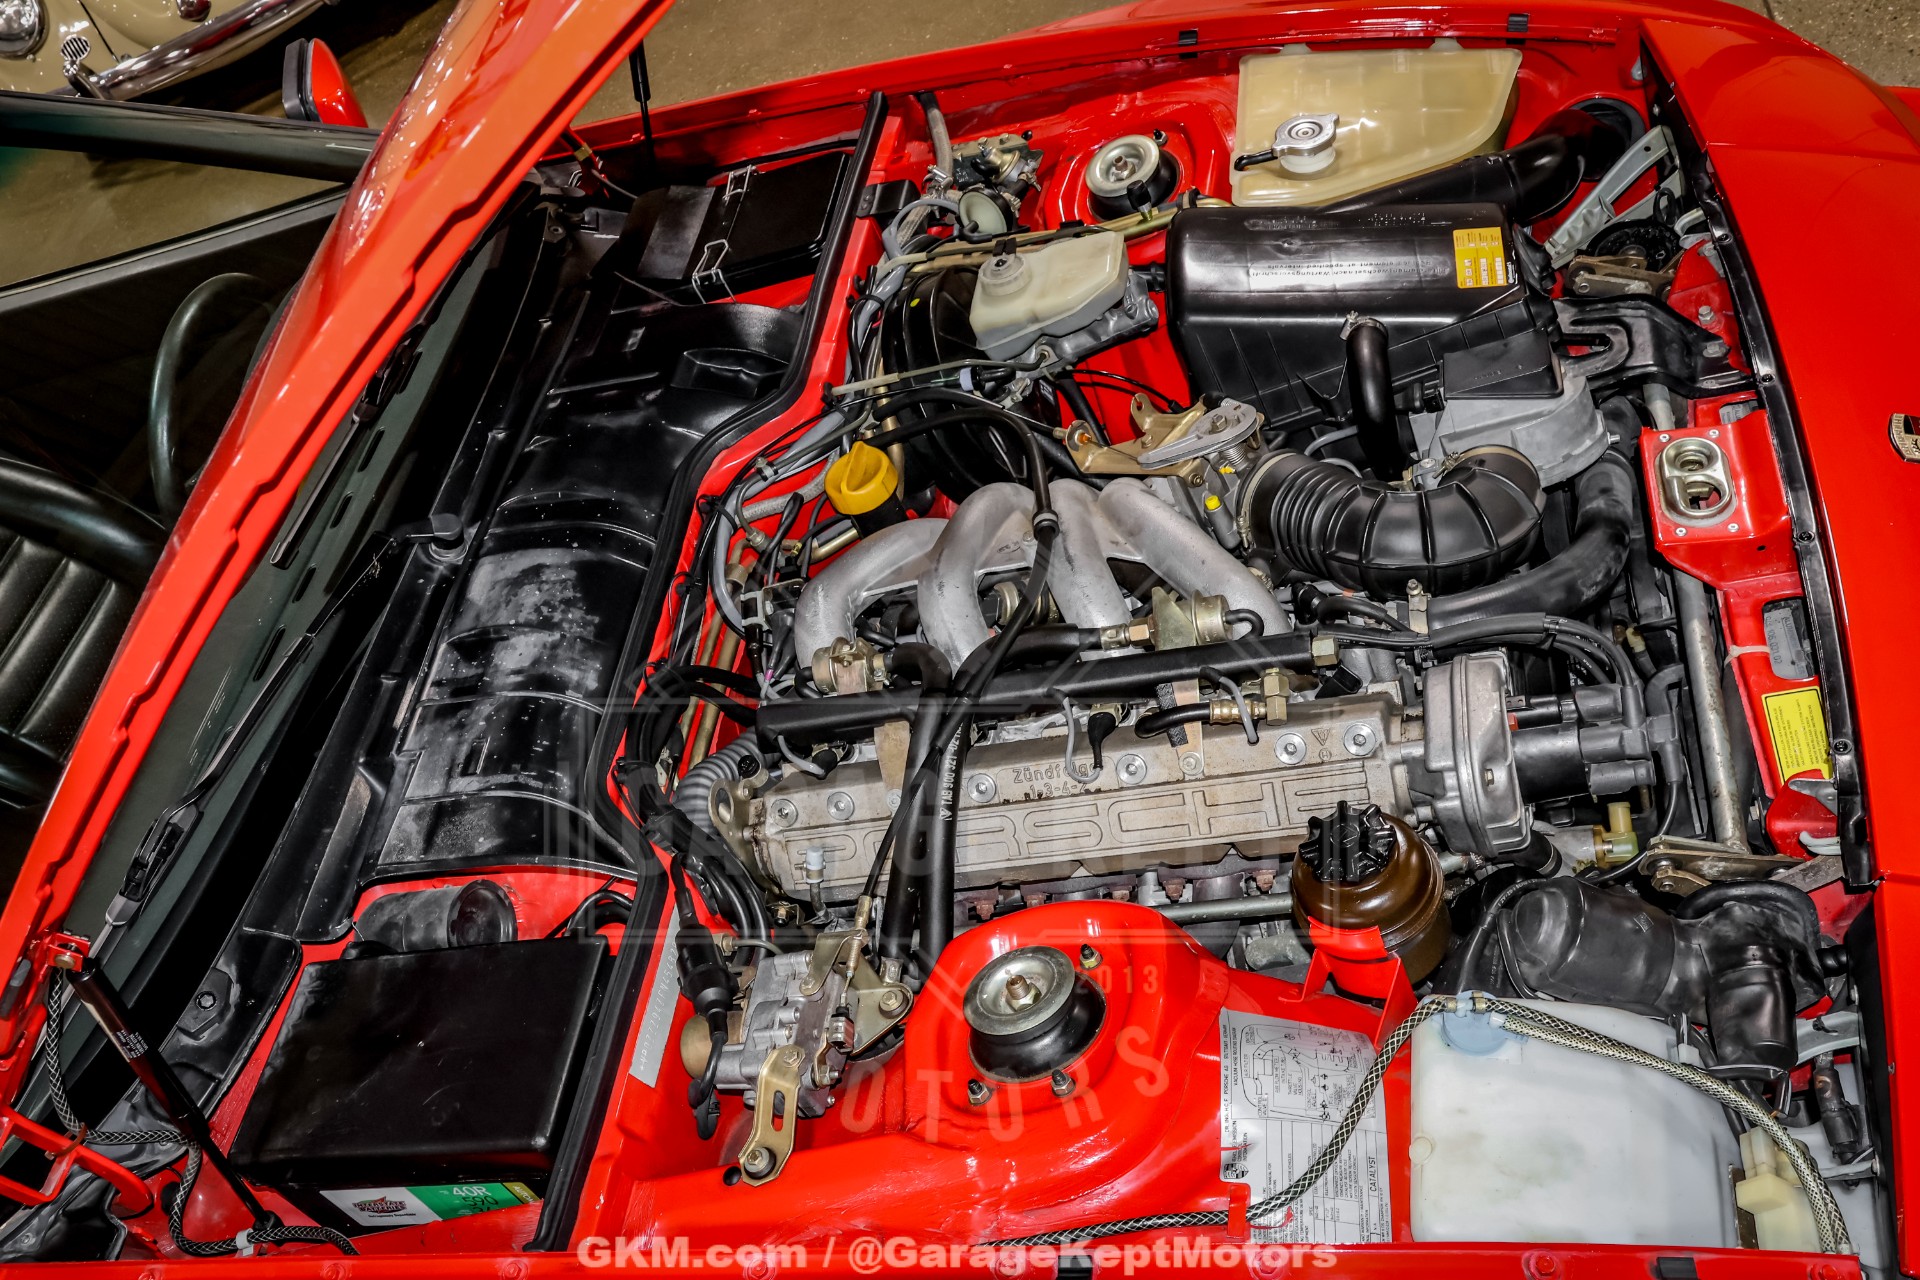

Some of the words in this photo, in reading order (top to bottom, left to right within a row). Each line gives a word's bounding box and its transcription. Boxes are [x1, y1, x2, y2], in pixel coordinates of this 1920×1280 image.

[945, 755, 958, 771] 321
[943, 772, 956, 789] 900
[941, 790, 953, 806] TAB
[1369, 1156, 1377, 1192] CATALYST
[453, 1185, 492, 1197] 40R
[462, 1195, 499, 1207] 590
